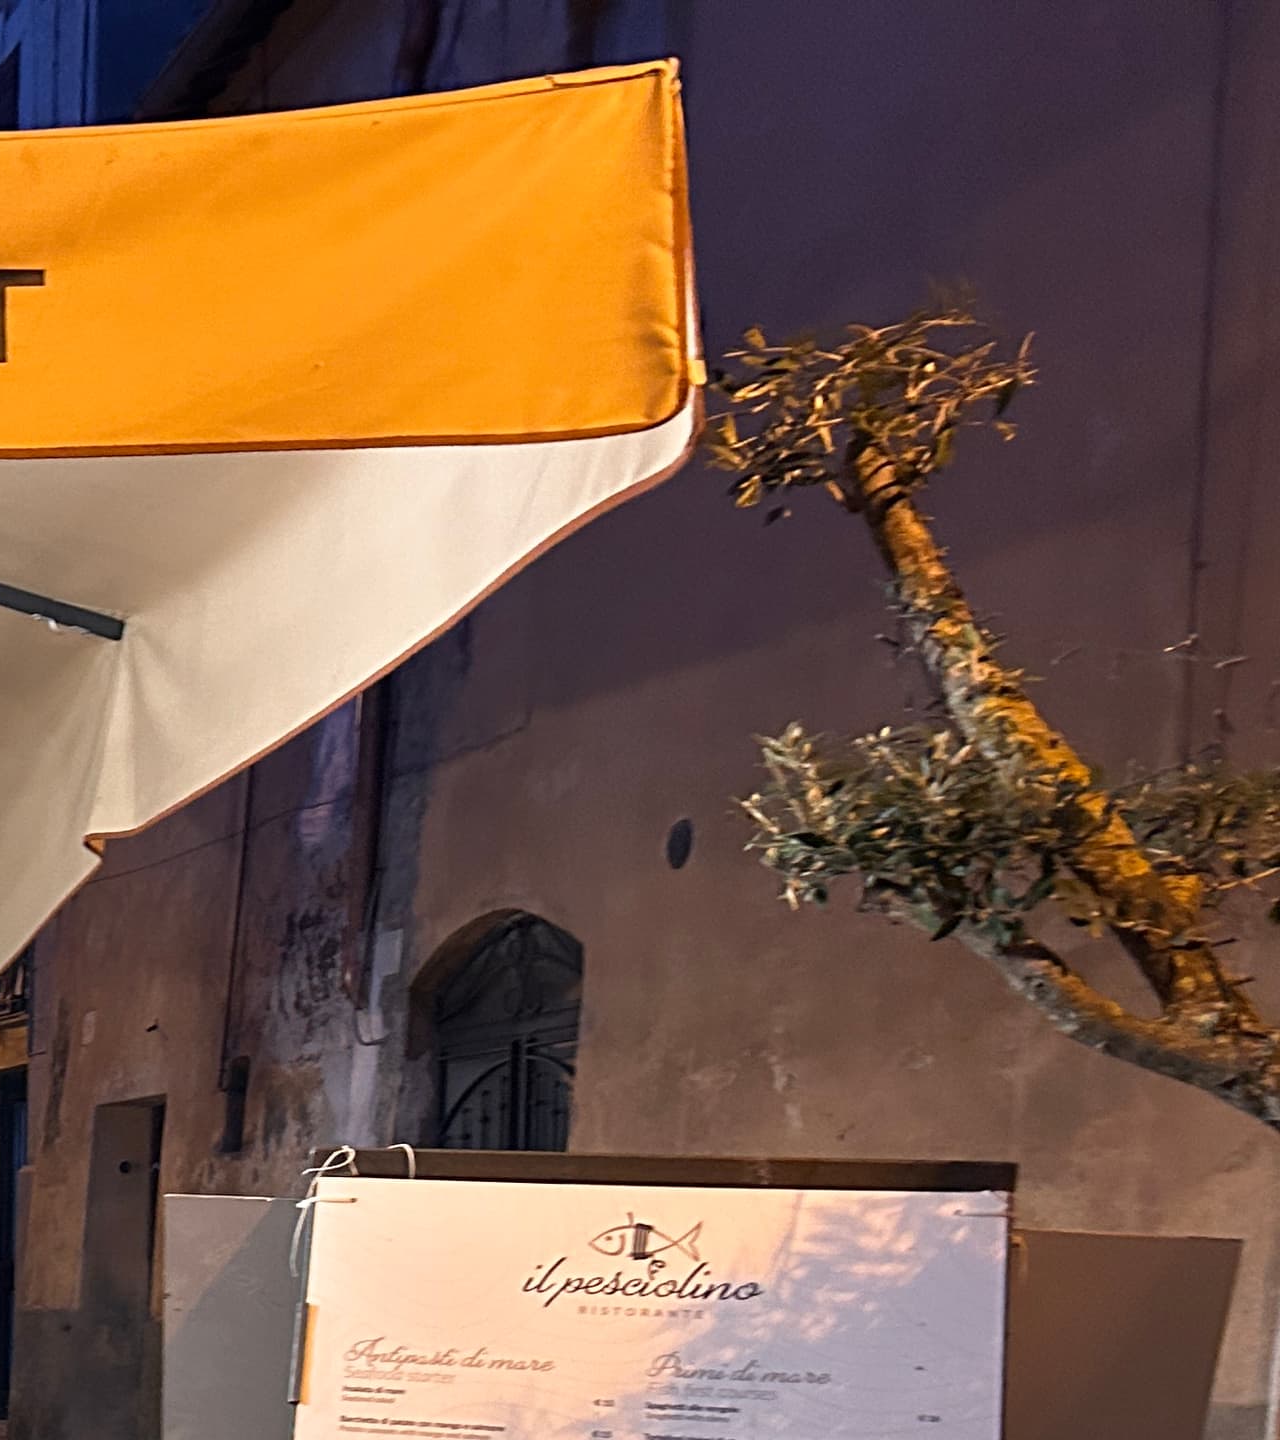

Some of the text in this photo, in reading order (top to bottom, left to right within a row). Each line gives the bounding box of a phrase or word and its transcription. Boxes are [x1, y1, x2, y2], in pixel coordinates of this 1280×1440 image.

[522, 1257, 764, 1308] il pesciolino
[577, 1305, 705, 1320] RISTORANTE
[343, 1336, 557, 1373] Antipasti di mare
[647, 1351, 832, 1385] Primi di mare
